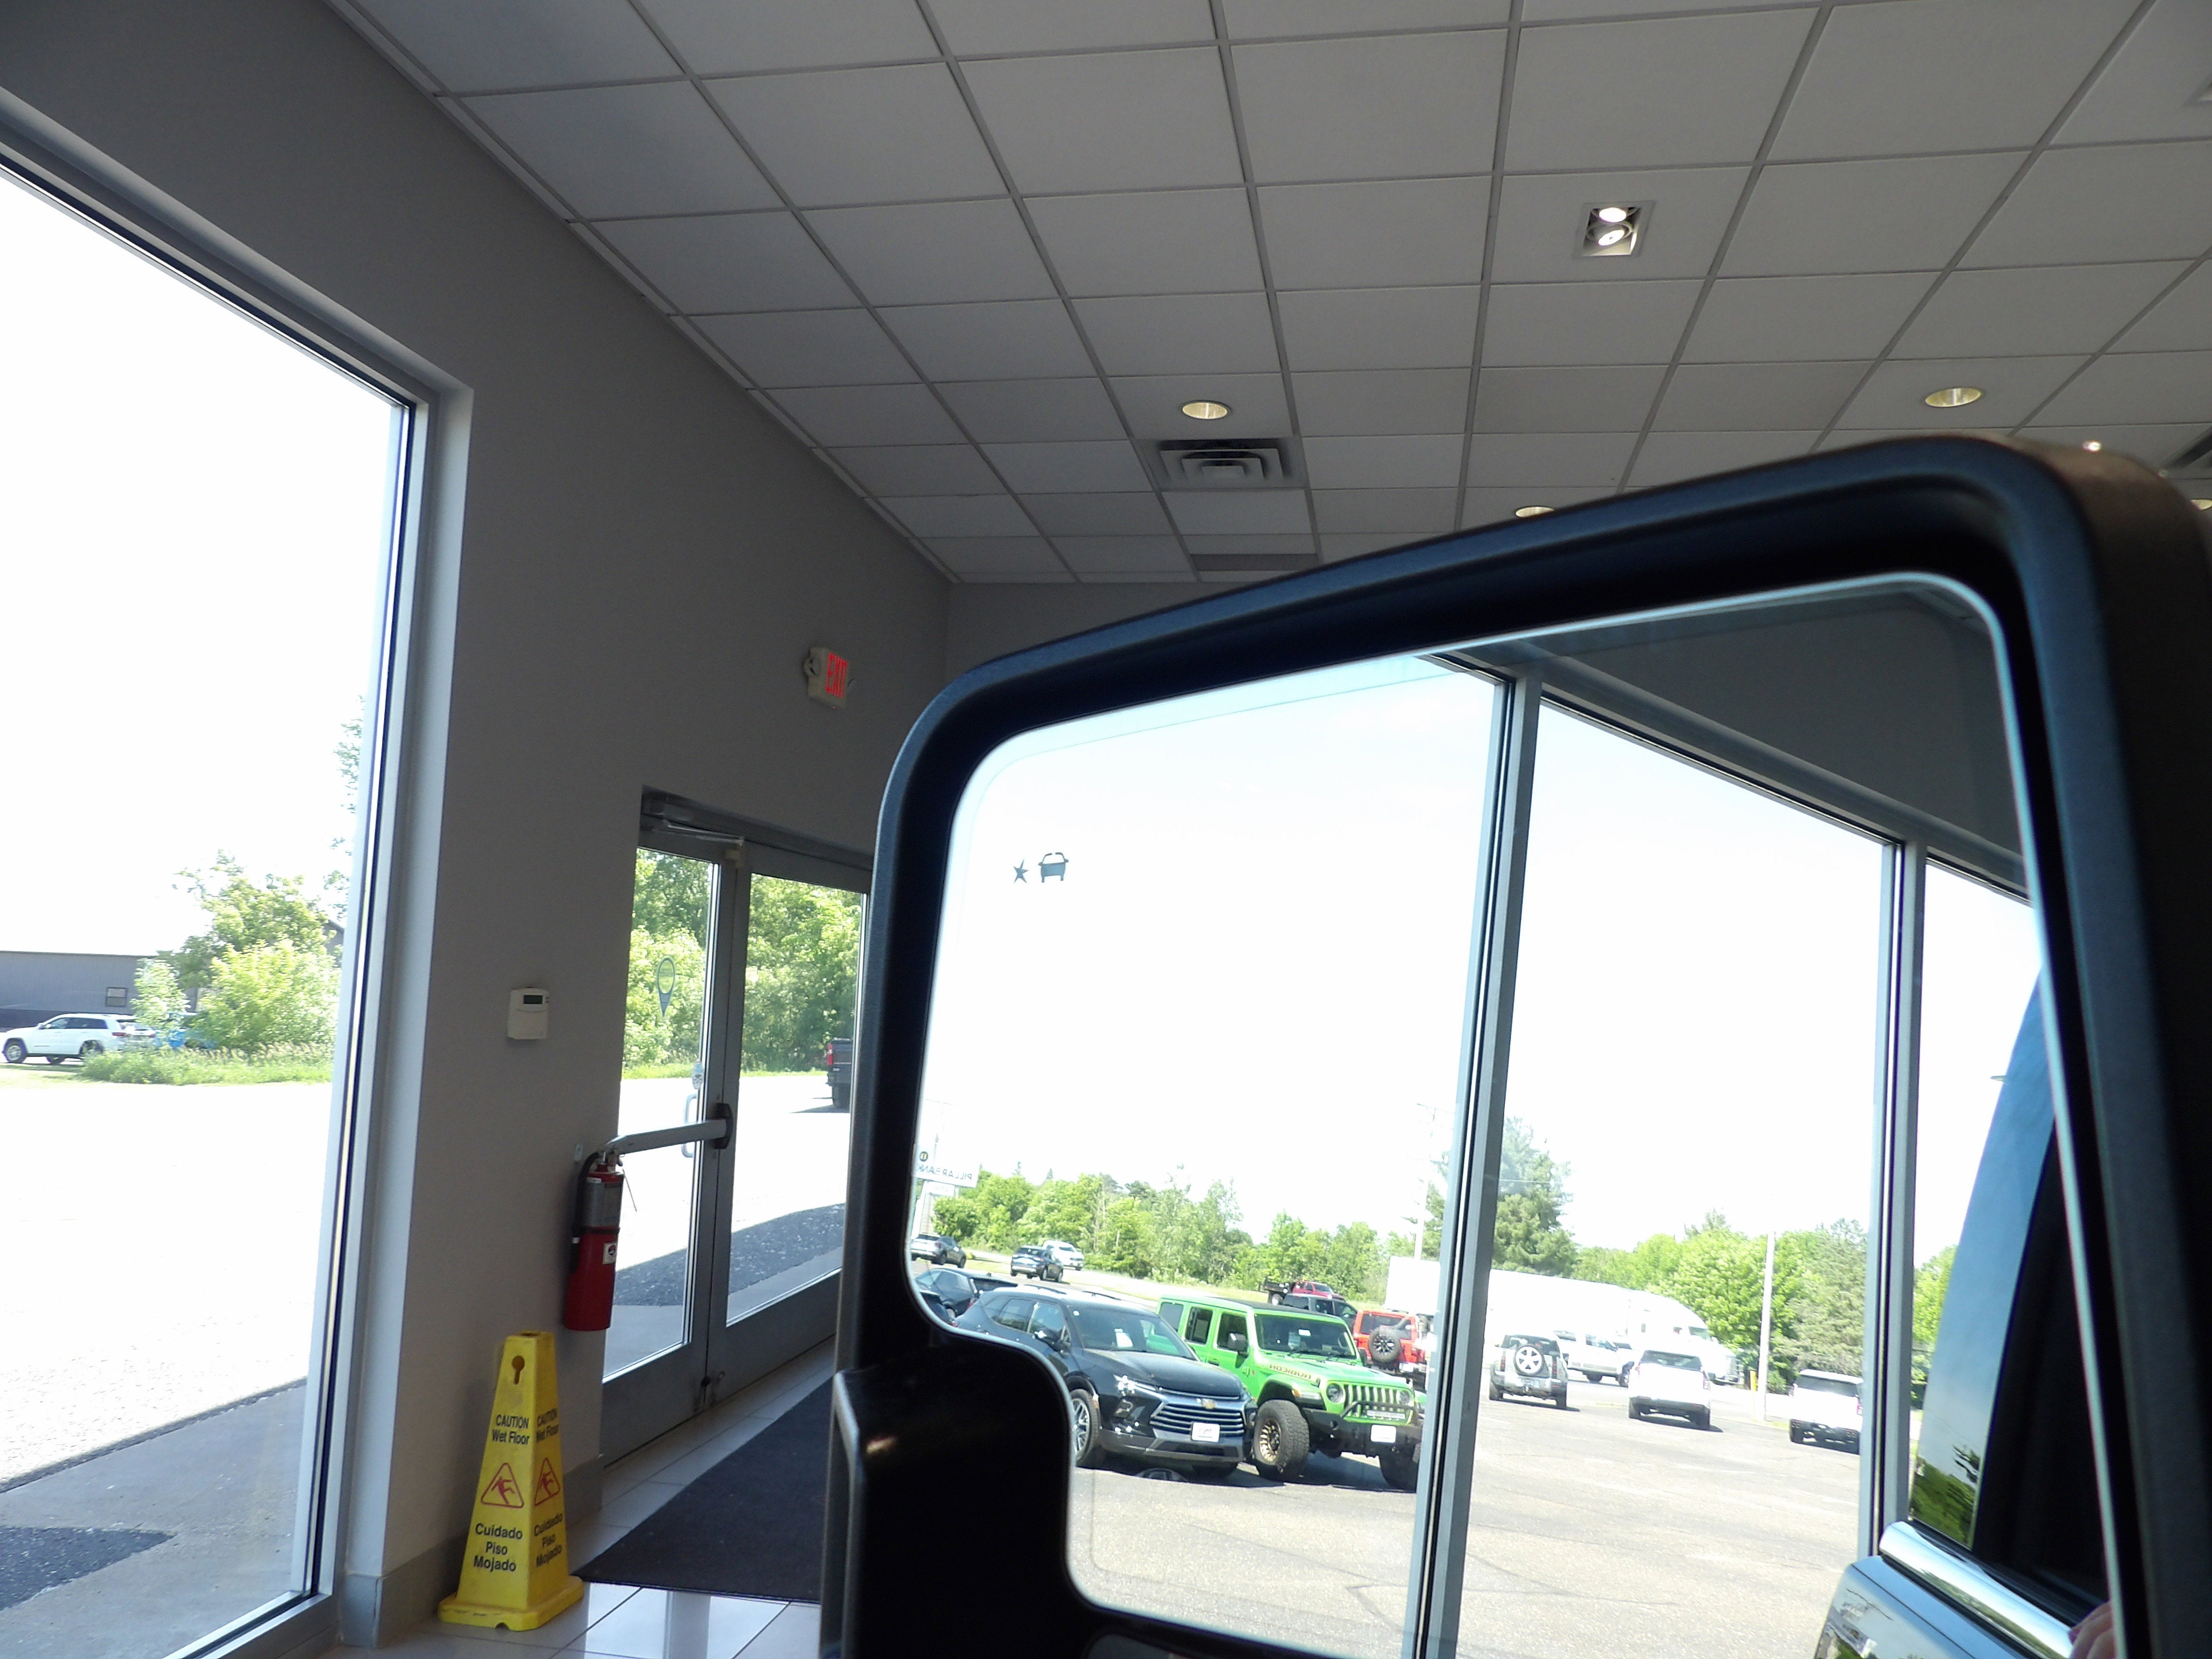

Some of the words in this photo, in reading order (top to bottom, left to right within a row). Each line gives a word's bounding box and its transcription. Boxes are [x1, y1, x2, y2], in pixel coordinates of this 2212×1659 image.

[826, 652, 849, 699] EXIT
[496, 1413, 529, 1429] CAUTION
[537, 1408, 558, 1427] CAUTION
[492, 1429, 507, 1443] Wet
[509, 1431, 530, 1445] Floor
[475, 1523, 523, 1539] Cuidado
[534, 1513, 564, 1536] Cuidado
[485, 1541, 508, 1555] Piso
[542, 1534, 556, 1548] Piso
[473, 1555, 517, 1572] Mojado
[536, 1544, 563, 1567] Mojado
